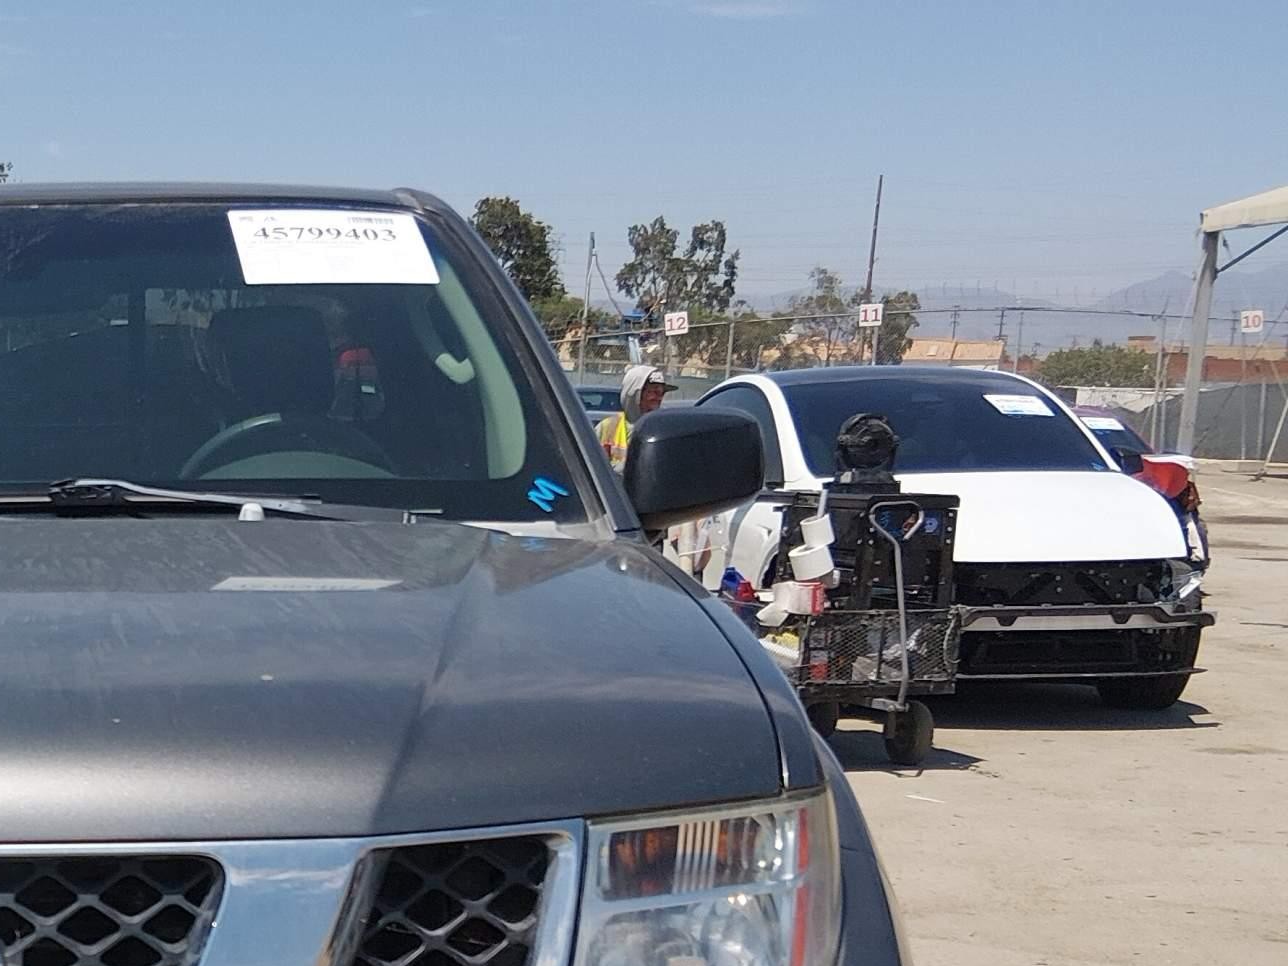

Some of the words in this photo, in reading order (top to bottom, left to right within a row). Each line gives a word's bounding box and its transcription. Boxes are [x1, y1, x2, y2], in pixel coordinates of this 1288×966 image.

[253, 226, 398, 242] 45799403
[860, 307, 881, 323] 11
[1242, 314, 1262, 329] 10
[666, 316, 687, 332] 12
